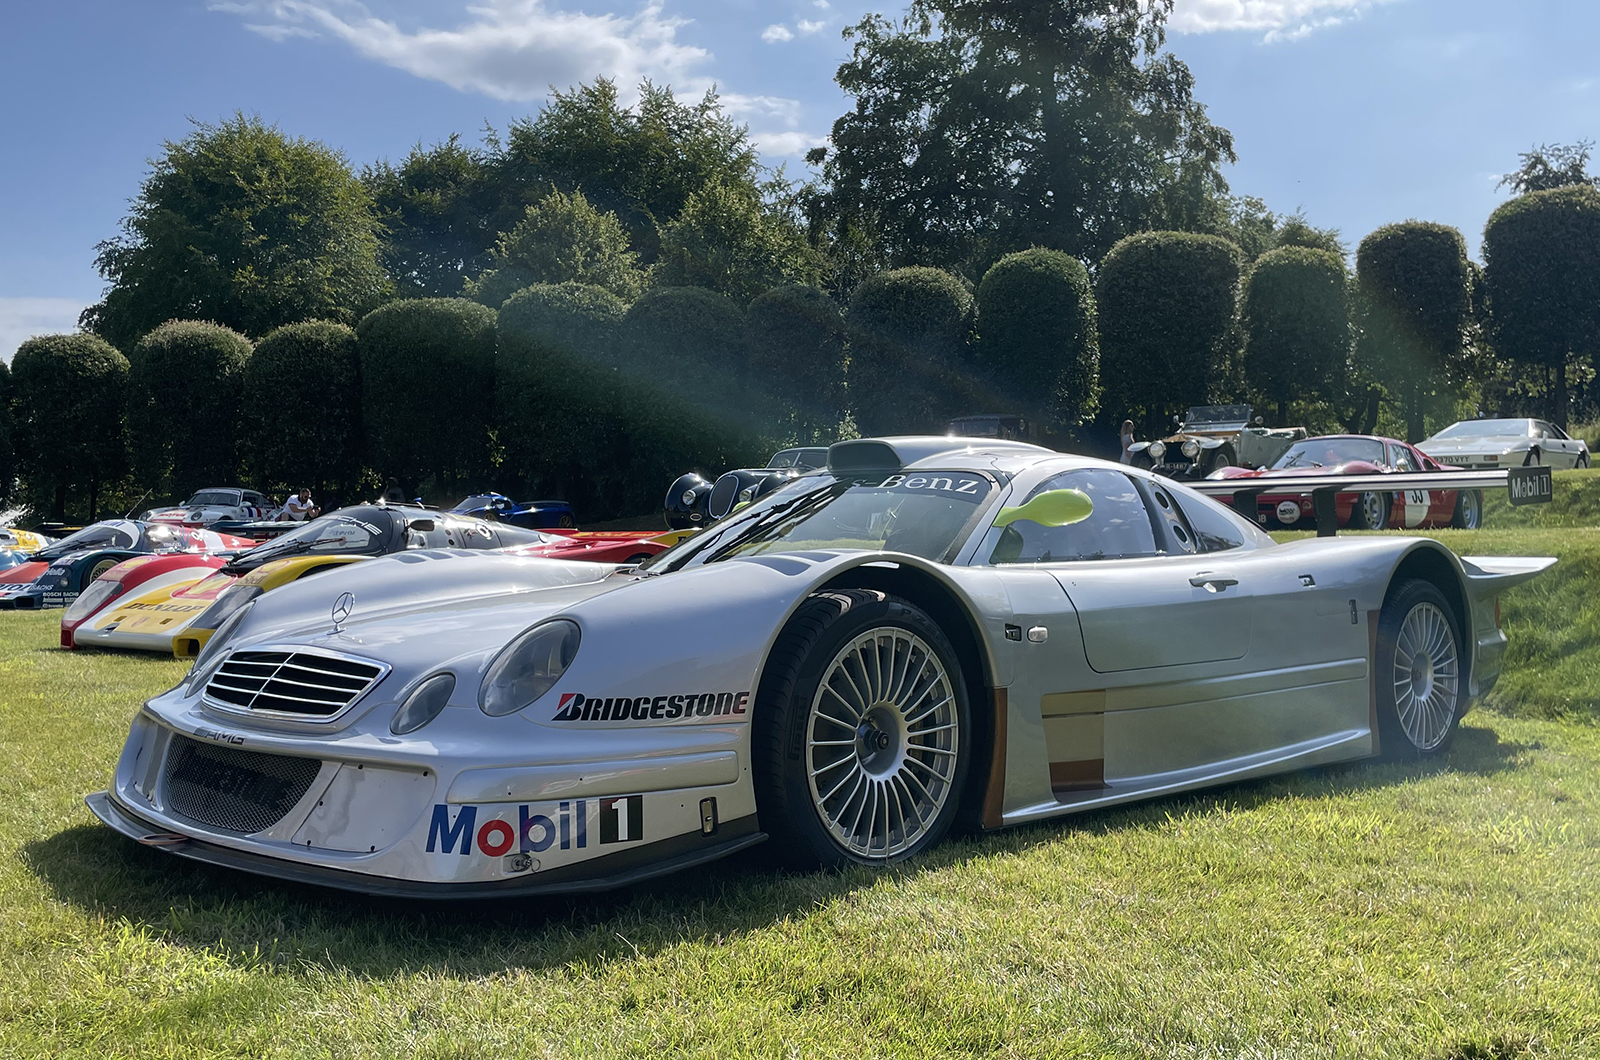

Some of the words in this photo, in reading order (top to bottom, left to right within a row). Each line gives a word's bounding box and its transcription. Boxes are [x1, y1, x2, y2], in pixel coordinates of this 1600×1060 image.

[850, 473, 980, 495] s-Benz
[1511, 475, 1539, 499] Mobil
[124, 602, 206, 613] DUNLOP
[551, 690, 750, 722] BRIDGESTONE
[205, 730, 247, 746] AMG
[426, 800, 587, 858] Mobil
[609, 796, 634, 843] 1
